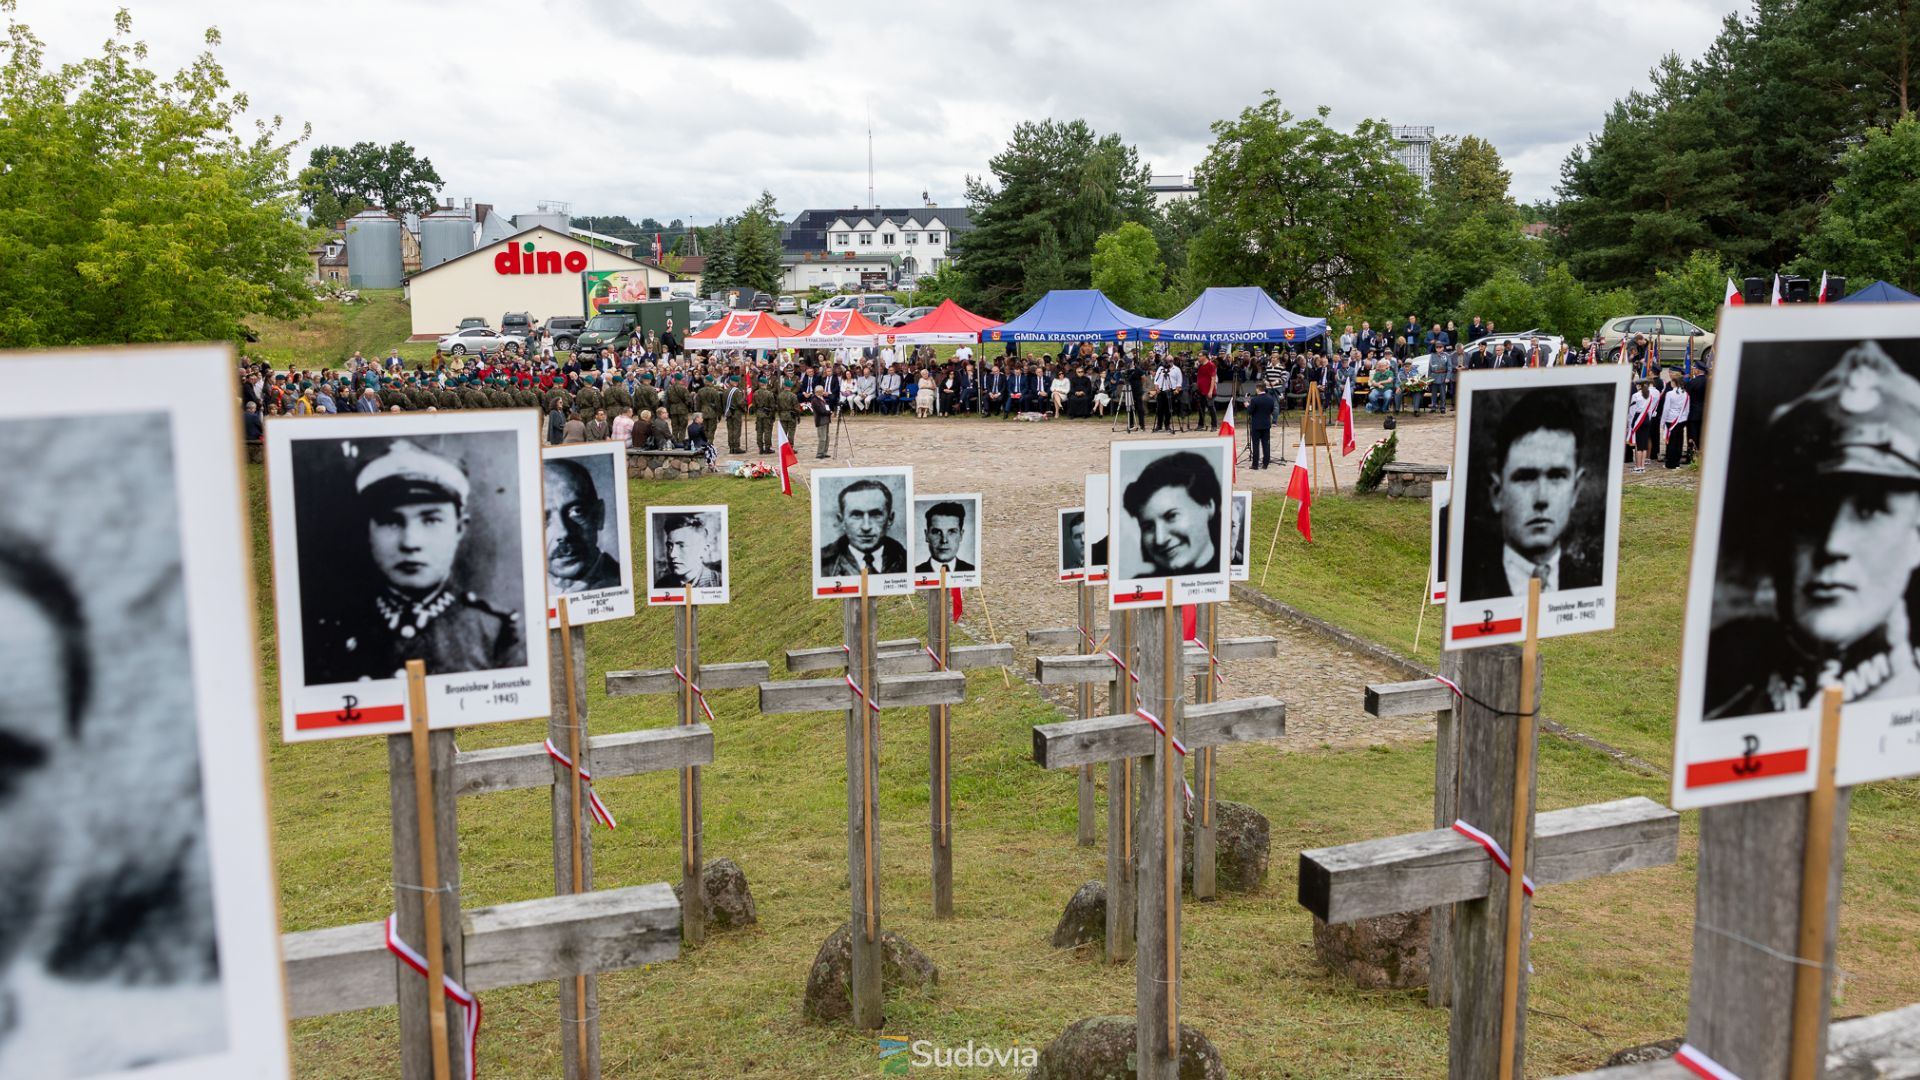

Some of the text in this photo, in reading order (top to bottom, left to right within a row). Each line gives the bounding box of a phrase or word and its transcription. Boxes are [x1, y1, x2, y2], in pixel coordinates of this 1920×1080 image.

[494, 241, 588, 275] dino
[1014, 332, 1103, 341] GMINA KRASNOPOL
[1173, 332, 1270, 341] GMINA KRASNOPOL
